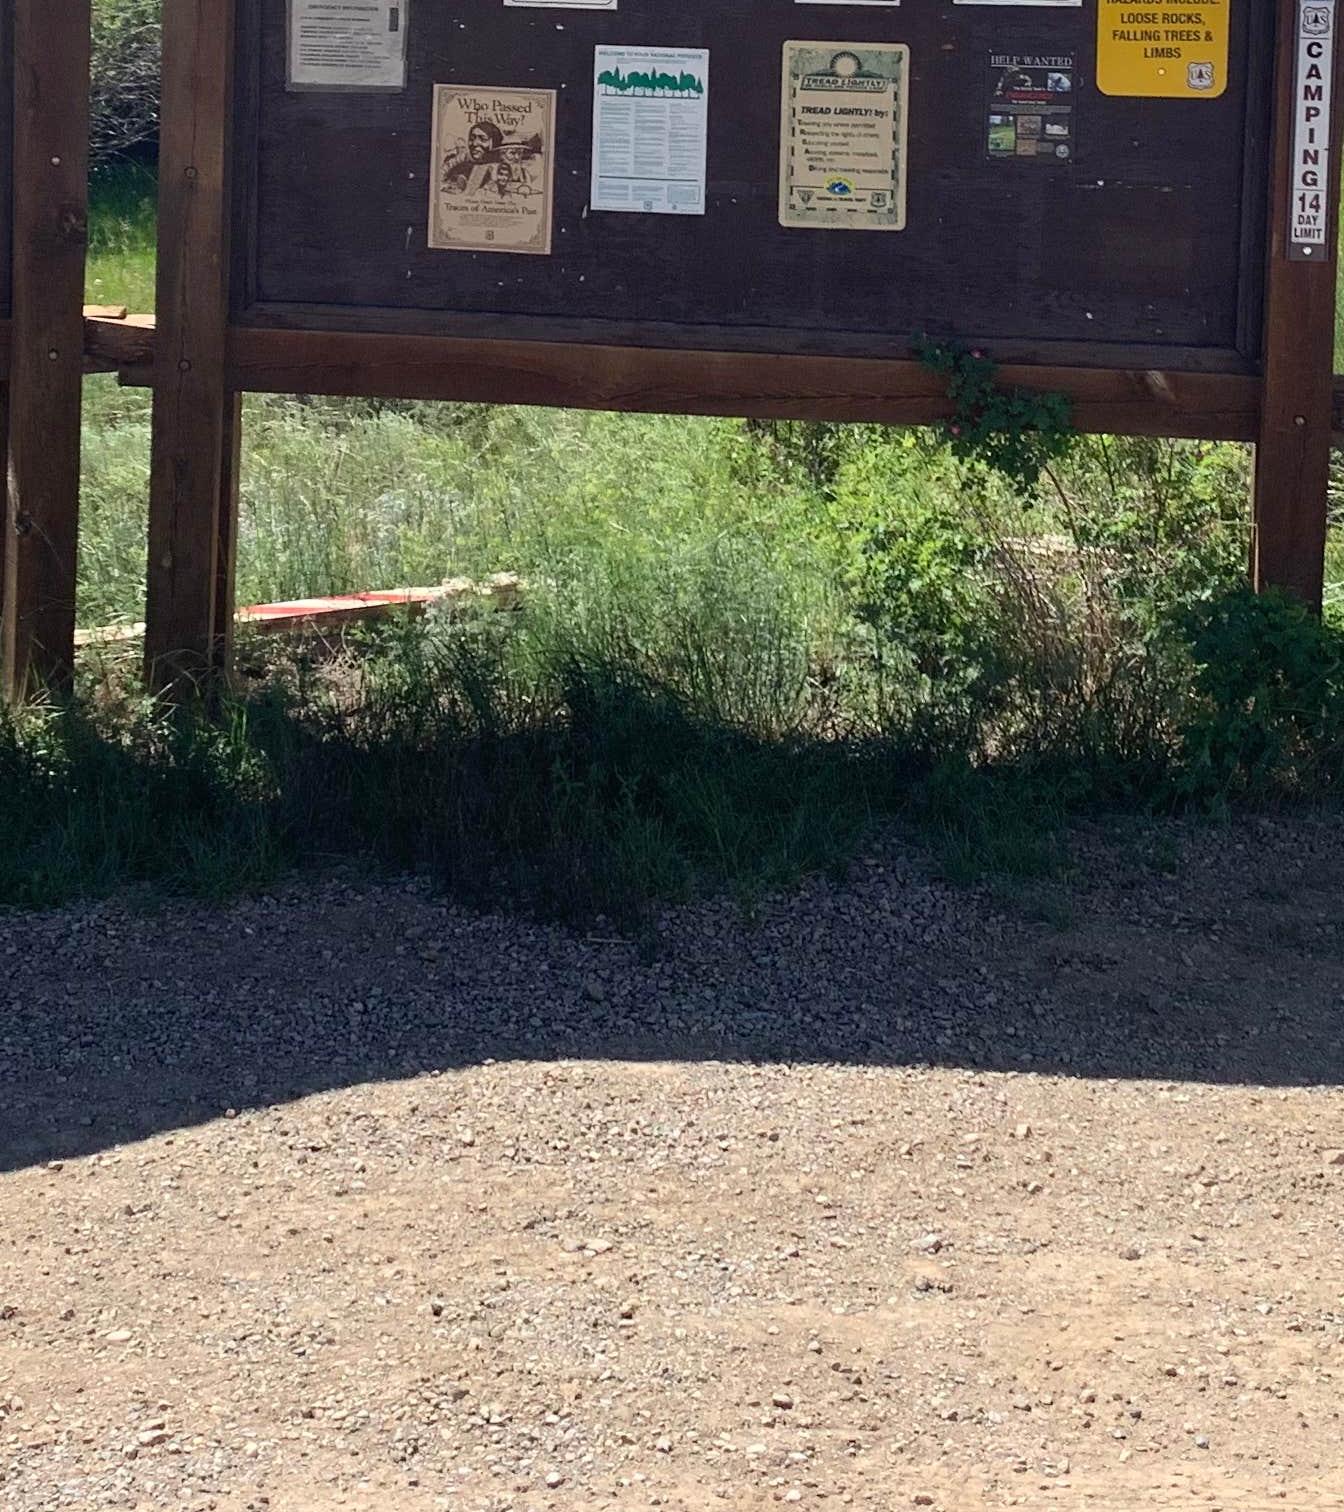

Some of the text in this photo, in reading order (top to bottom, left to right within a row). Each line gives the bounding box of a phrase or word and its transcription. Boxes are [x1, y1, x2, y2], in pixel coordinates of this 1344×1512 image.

[1121, 13, 1205, 25] LOOSE ROCKS,
[1113, 31, 1213, 41] FALLING TREES &
[1144, 48, 1181, 58] LIMBS
[991, 55, 1072, 66] HELP WANTED
[841, 79, 886, 87] LIGHTLY!
[457, 98, 531, 113] Who Passed
[801, 106, 888, 118] TREAD LIGHTLY! by:
[1301, 41, 1323, 187] CAMPING
[465, 111, 525, 127] This Way?
[471, 203, 479, 212] of
[1298, 192, 1321, 213] 14
[1297, 214, 1319, 226] DAY
[1294, 227, 1322, 239] LIMIT
